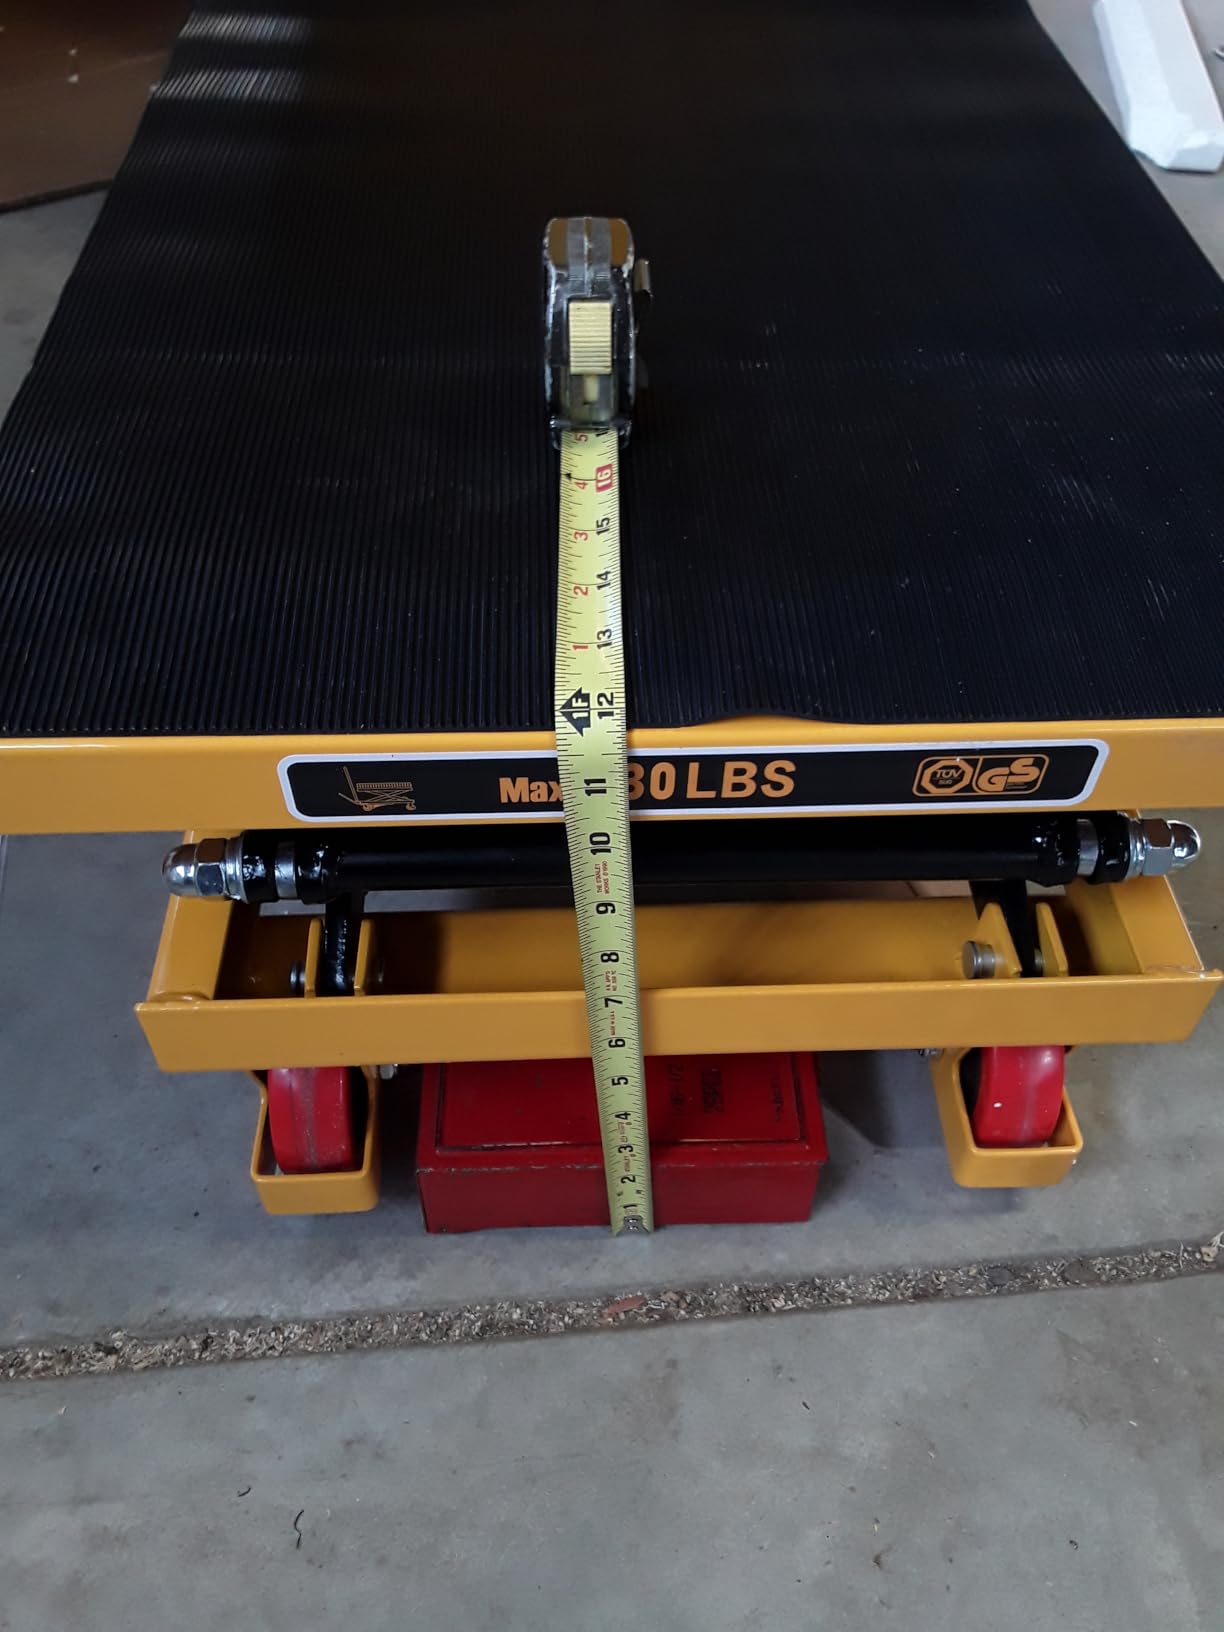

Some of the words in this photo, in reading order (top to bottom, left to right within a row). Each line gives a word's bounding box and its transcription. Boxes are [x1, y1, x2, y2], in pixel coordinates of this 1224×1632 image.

[597, 467, 612, 489] 16
[575, 481, 588, 490] 4
[596, 517, 610, 535] 15
[574, 531, 588, 541] 3
[596, 571, 611, 590] 14
[573, 586, 589, 596] 2
[597, 629, 612, 649] 13
[597, 692, 614, 720] 12
[977, 757, 1040, 792] GS
[499, 776, 563, 803] Max
[584, 778, 607, 797] 11
[589, 832, 612, 855] 10
[596, 902, 616, 915] 9
[600, 952, 620, 963] 8
[604, 998, 623, 1008] 7
[608, 1038, 626, 1048] 6
[611, 1076, 629, 1086] 5
[615, 1111, 631, 1120] 4
[618, 1145, 634, 1154] 3
[620, 1175, 636, 1184] 2
